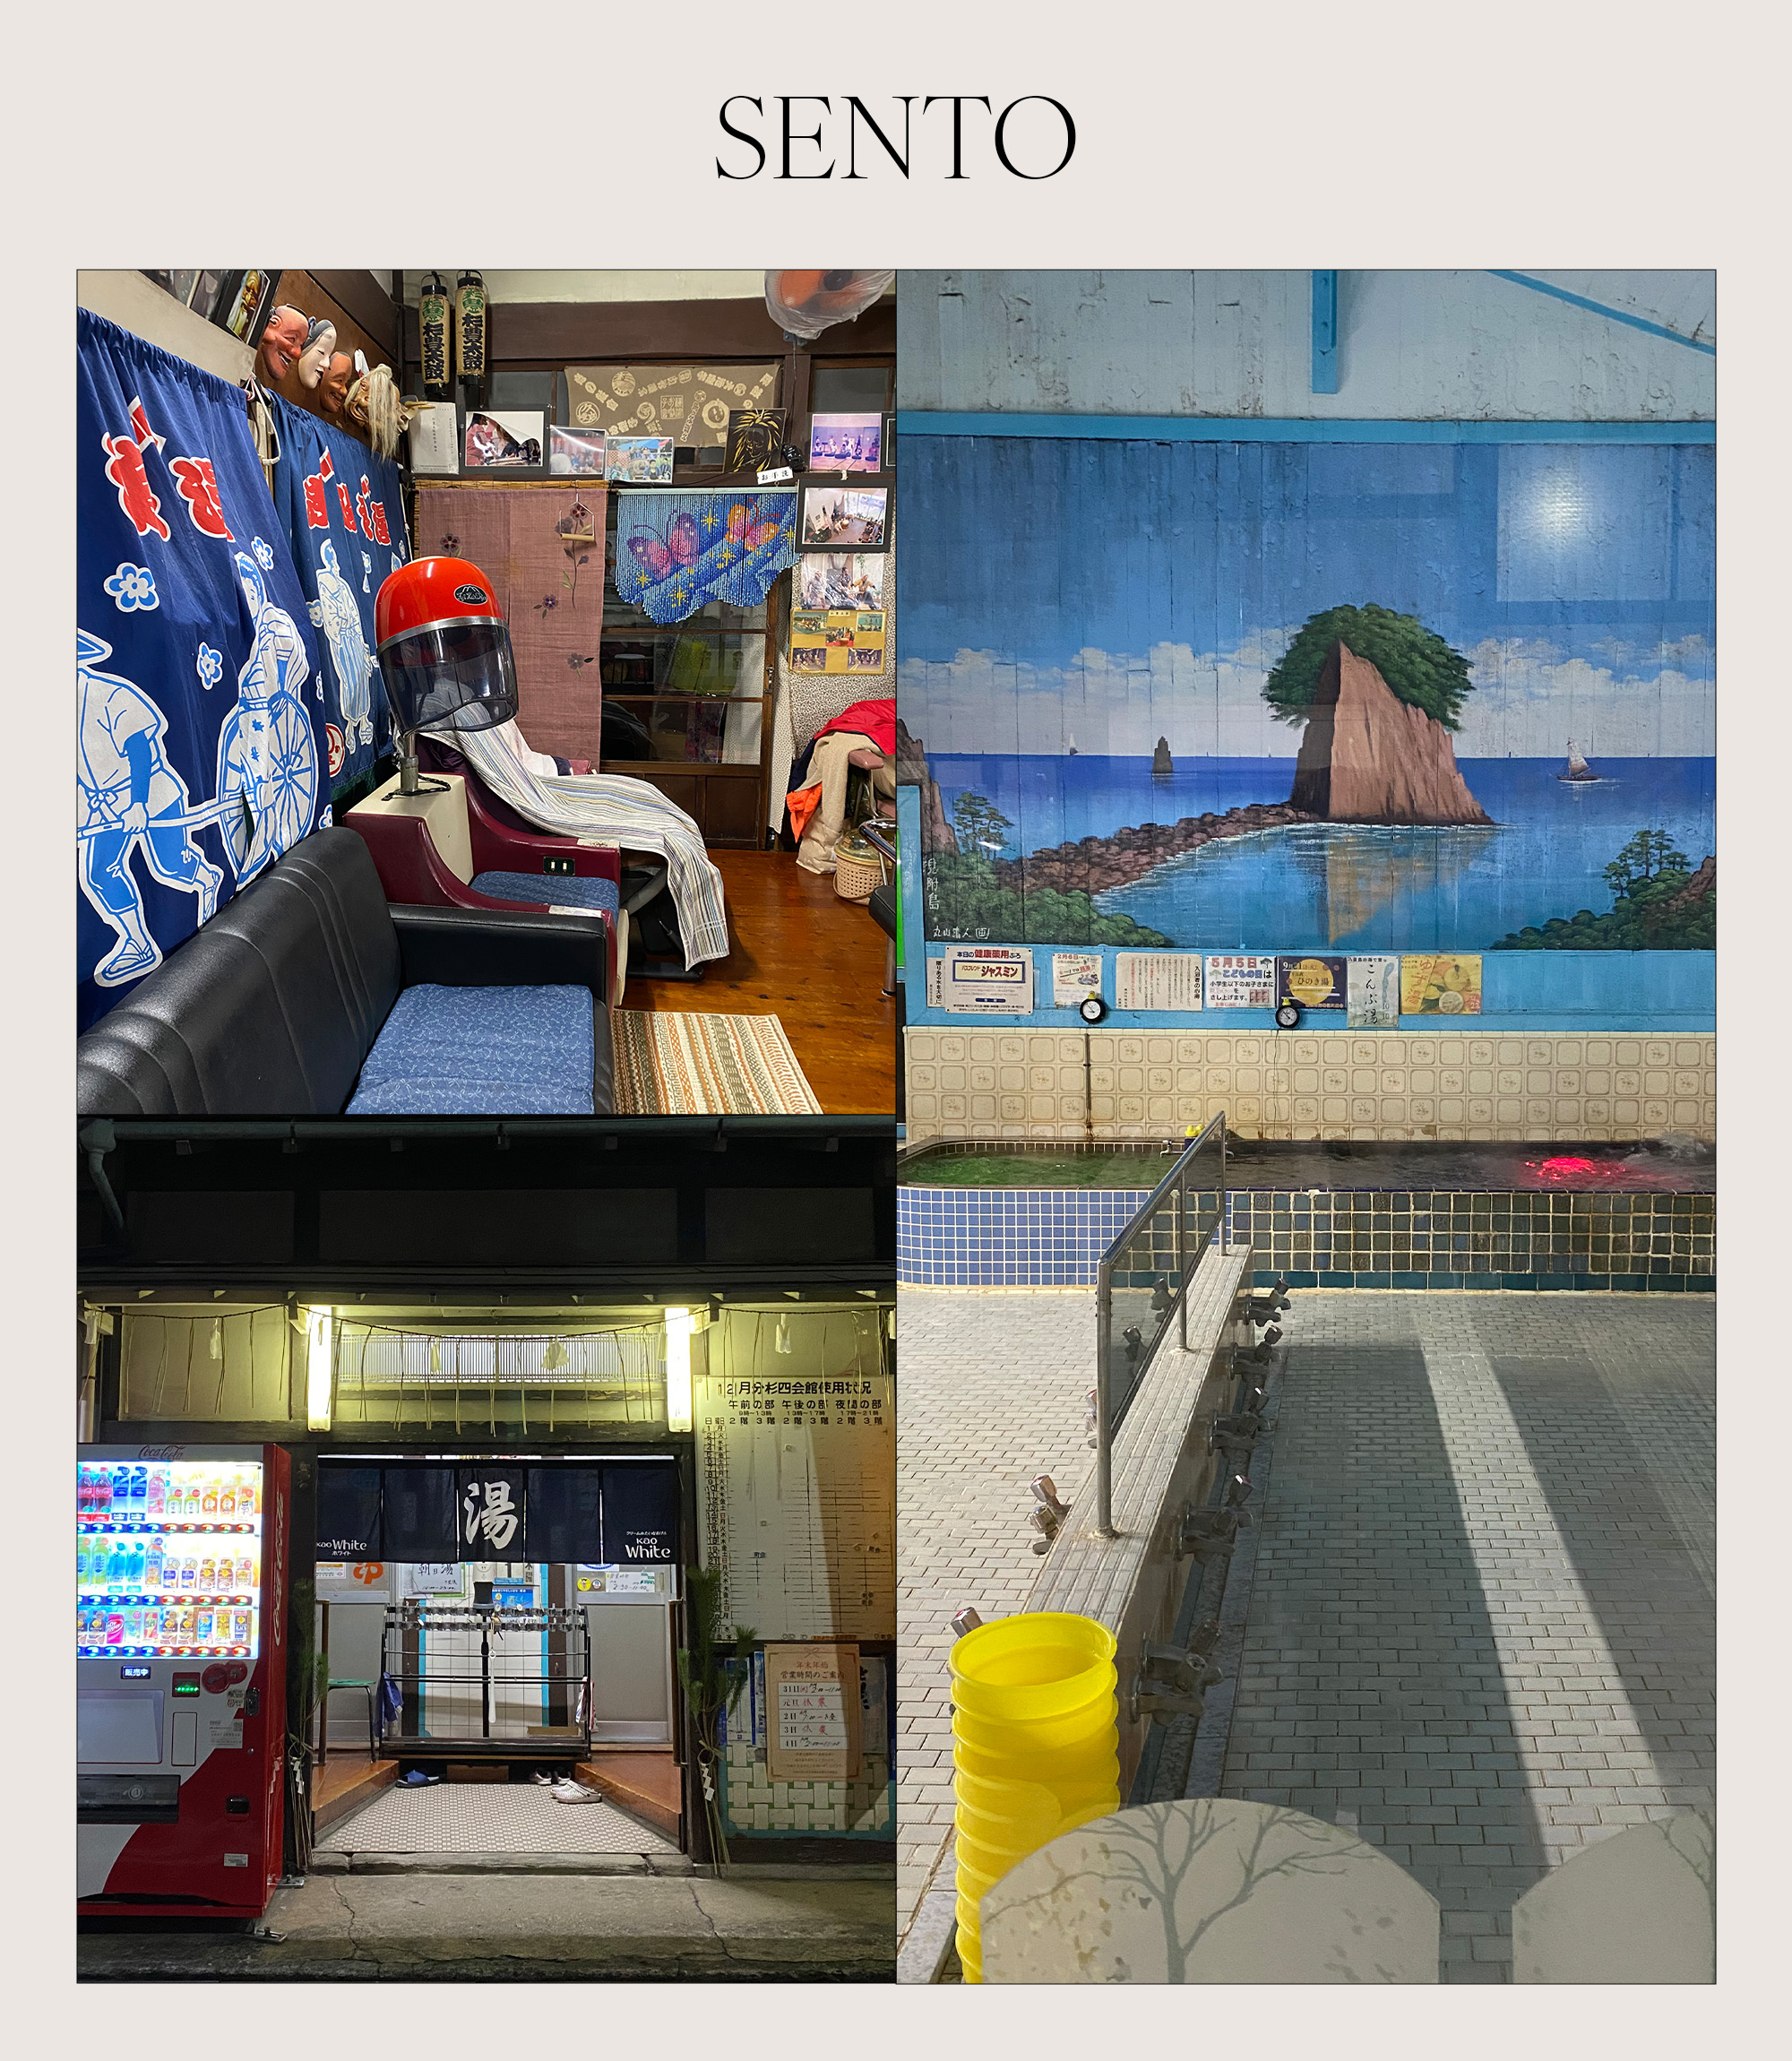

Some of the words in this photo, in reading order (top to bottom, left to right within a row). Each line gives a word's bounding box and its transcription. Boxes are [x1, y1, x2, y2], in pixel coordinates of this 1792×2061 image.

[1211, 957, 1257, 969] 5月5日
[981, 965, 1018, 978] ジャスミン
[1222, 970, 1272, 979] こどもの日は
[1297, 978, 1329, 987] ひのき湯
[1364, 964, 1377, 1024] こんぶ湯
[728, 1400, 774, 1410] 午前の部
[782, 1400, 828, 1410] 午後の部
[464, 1480, 518, 1550] 湯
[332, 1539, 367, 1551] White
[625, 1544, 671, 1559] White
[125, 1669, 149, 1677] 販売中
[780, 1670, 845, 1679] 営業時間のご案内
[783, 1699, 799, 1707] 元旦
